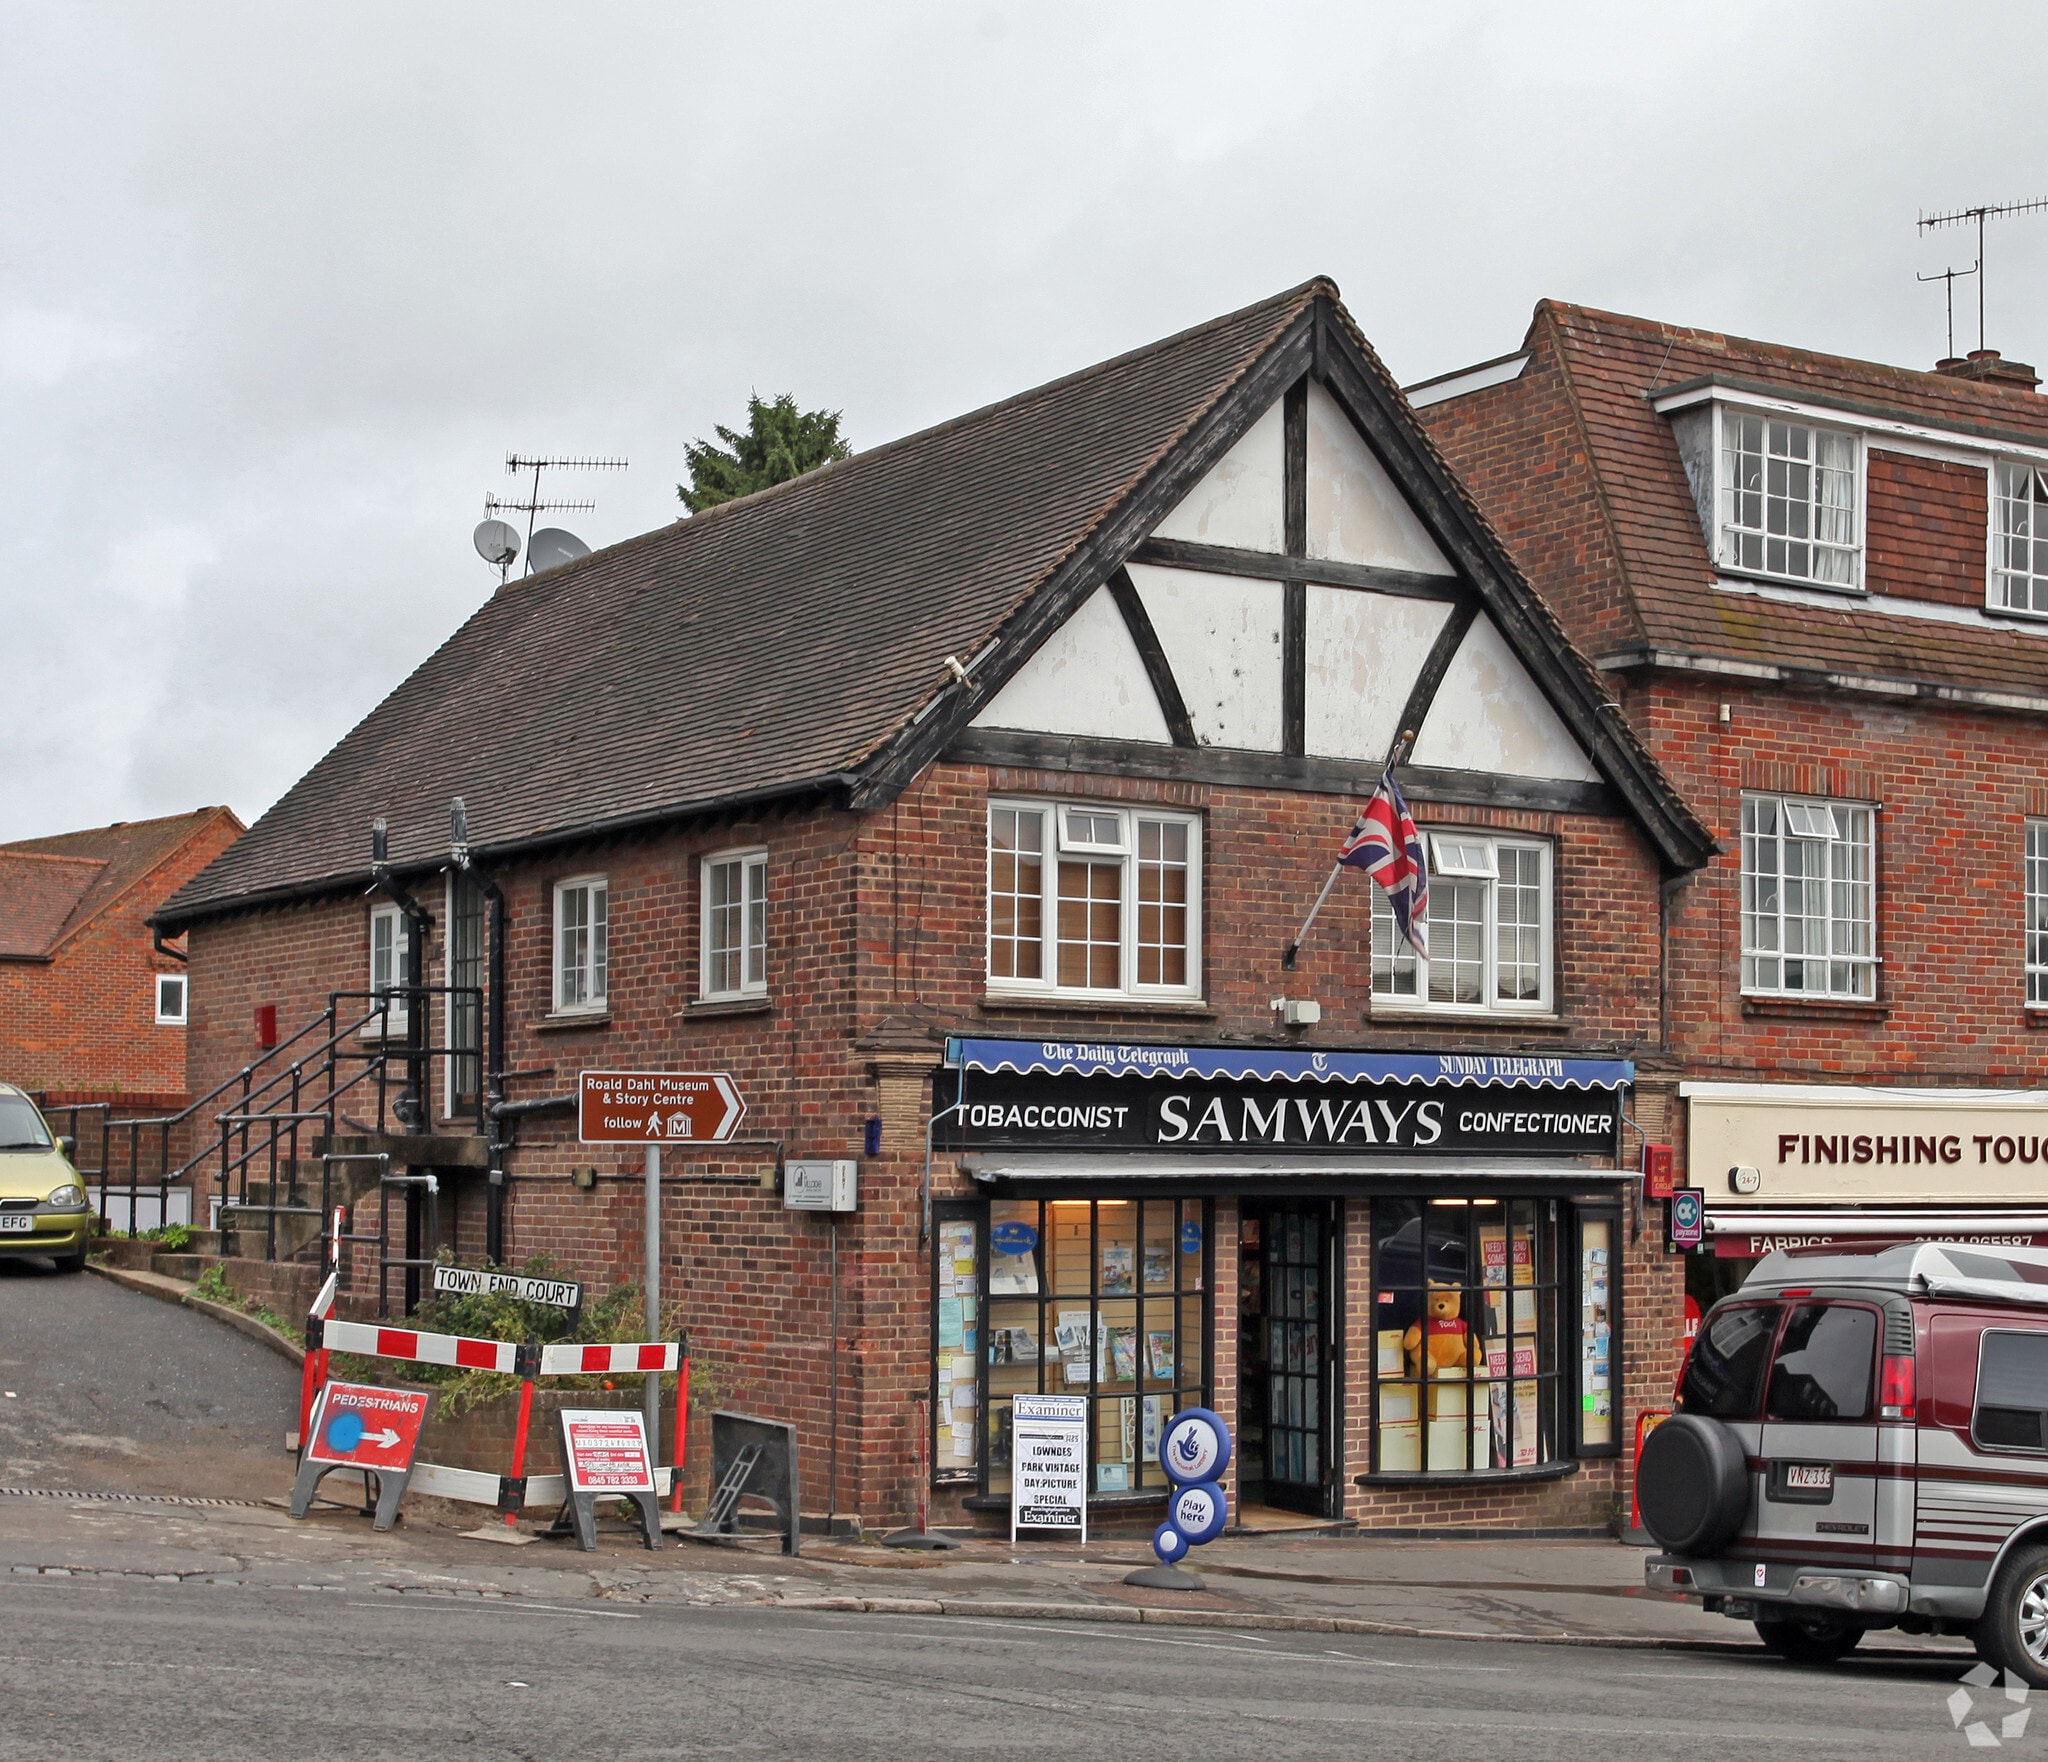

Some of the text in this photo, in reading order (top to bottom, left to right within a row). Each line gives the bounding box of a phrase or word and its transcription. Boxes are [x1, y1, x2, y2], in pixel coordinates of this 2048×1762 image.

[1042, 1042, 1190, 1067] The Daily Telegraph
[1439, 1055, 1563, 1076] SUNDAY TELEGRAPH
[586, 1078, 709, 1091] Roald Dahl Museum
[602, 1093, 694, 1106] & Story Centre
[604, 1116, 642, 1128] follow
[956, 1094, 1612, 1147] TOBACCONIST SAMWAYS CONFECTIONER
[1777, 1133, 1962, 1165] FINISHING
[2, 1216, 27, 1229] EFG
[1675, 1229, 1699, 1238] payzone
[1485, 1241, 1501, 1253] NEED
[439, 1269, 575, 1305] TOWN END COURT
[1439, 1320, 1457, 1328] Pooh
[1490, 1352, 1531, 1365] NEED SEND
[332, 1393, 419, 1414] PEDESTRIANS
[1017, 1402, 1081, 1416] Examiner
[1032, 1446, 1072, 1457] LOWNDES
[1520, 1448, 1536, 1456] DH
[1021, 1462, 1080, 1473] PARK VINTAGE
[587, 1476, 638, 1484] 0845 782 3333
[1033, 1495, 1067, 1505] SPECIAL
[1182, 1499, 1206, 1513] Play
[1023, 1511, 1077, 1523] Examiner
[1180, 1510, 1205, 1522] here
[1817, 1523, 1867, 1533] CHEVROLET
